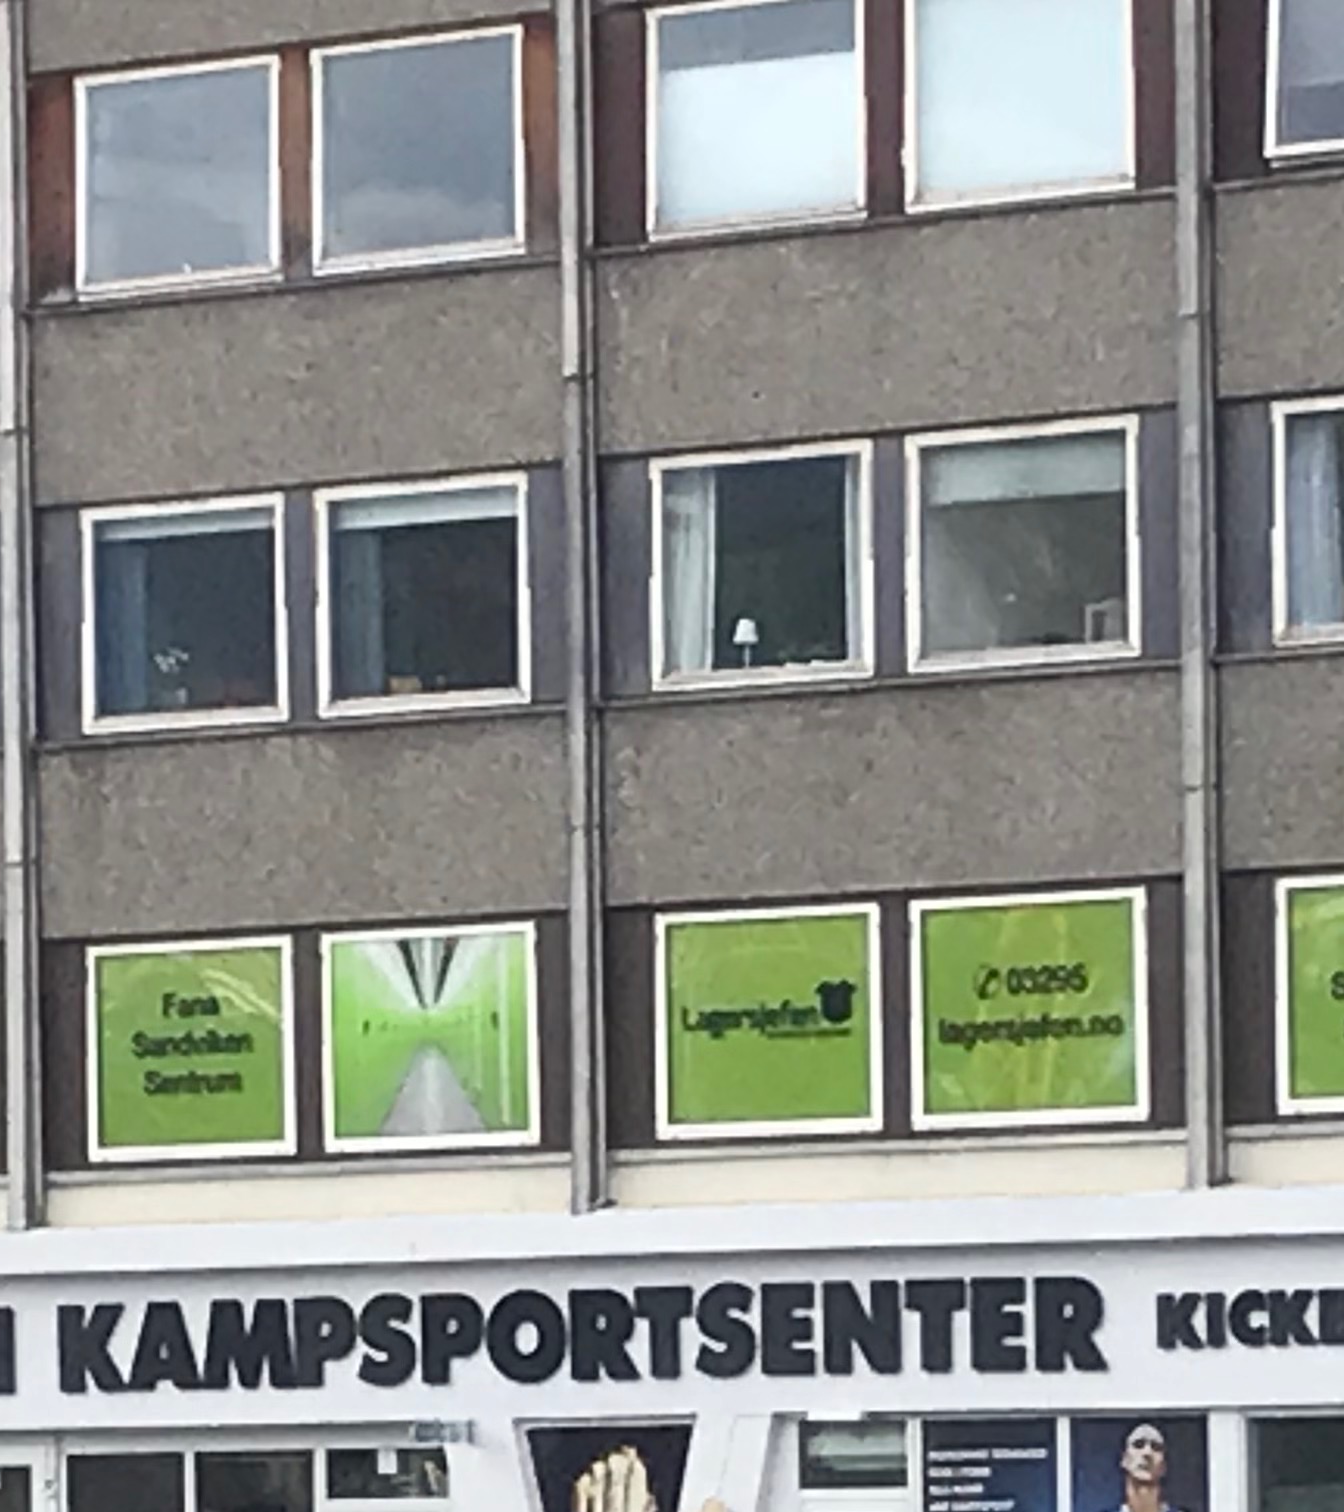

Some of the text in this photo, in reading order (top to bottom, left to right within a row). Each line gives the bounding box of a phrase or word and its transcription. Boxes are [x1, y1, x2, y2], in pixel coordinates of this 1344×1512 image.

[162, 992, 220, 1018] Fana
[682, 999, 820, 1040] Lagersjefen
[939, 1014, 1124, 1052] lagersjefen.no
[143, 1070, 243, 1096] Sentrum
[59, 1277, 1109, 1394] KAMPSPORTSENTER
